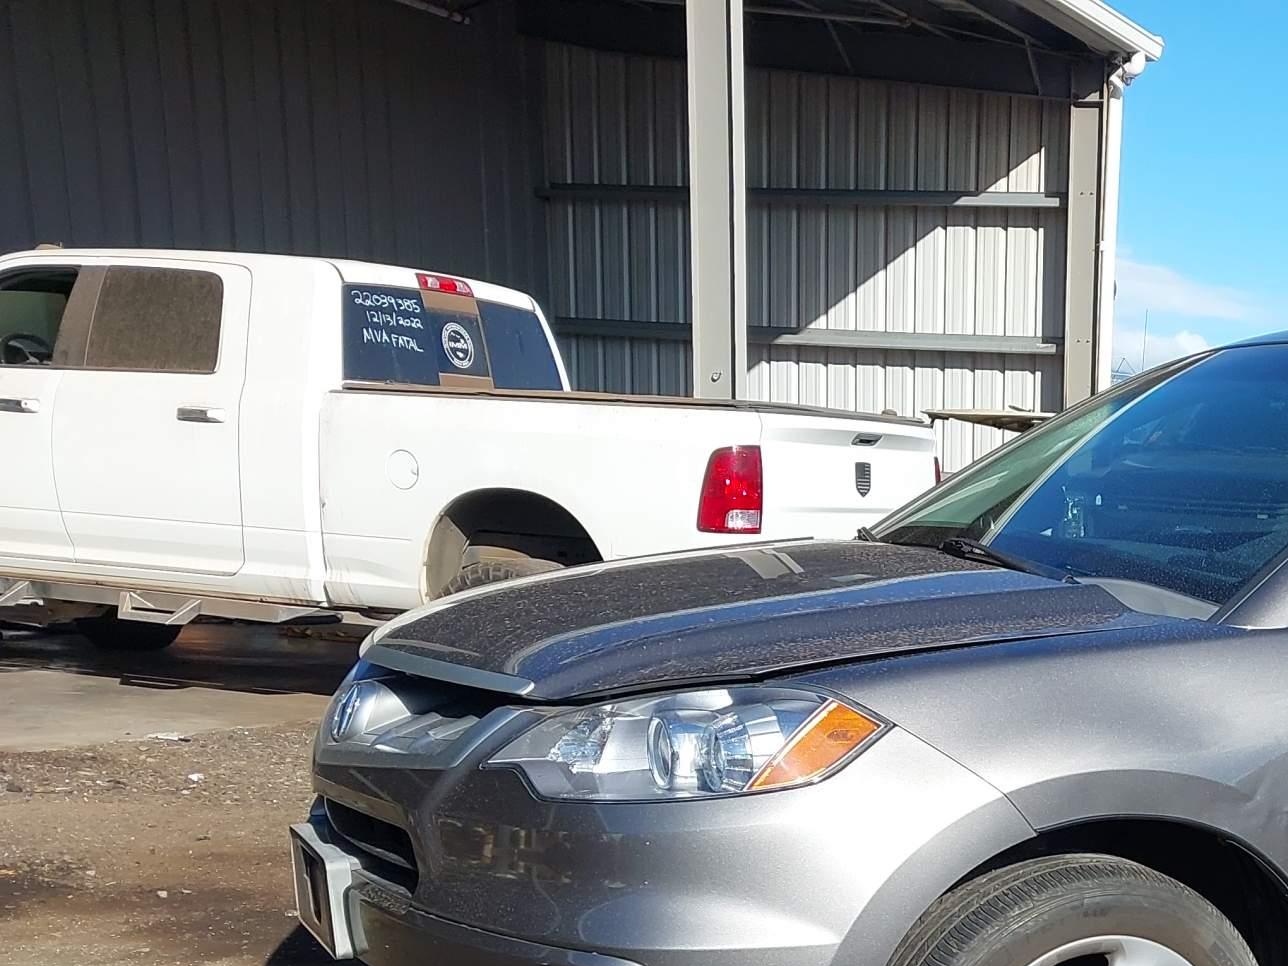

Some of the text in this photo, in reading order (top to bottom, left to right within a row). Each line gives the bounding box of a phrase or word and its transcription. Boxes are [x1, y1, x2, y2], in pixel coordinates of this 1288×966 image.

[351, 290, 420, 313] 22039385
[366, 310, 424, 329] 12/13/2022
[363, 326, 424, 352] MVA FATAL
